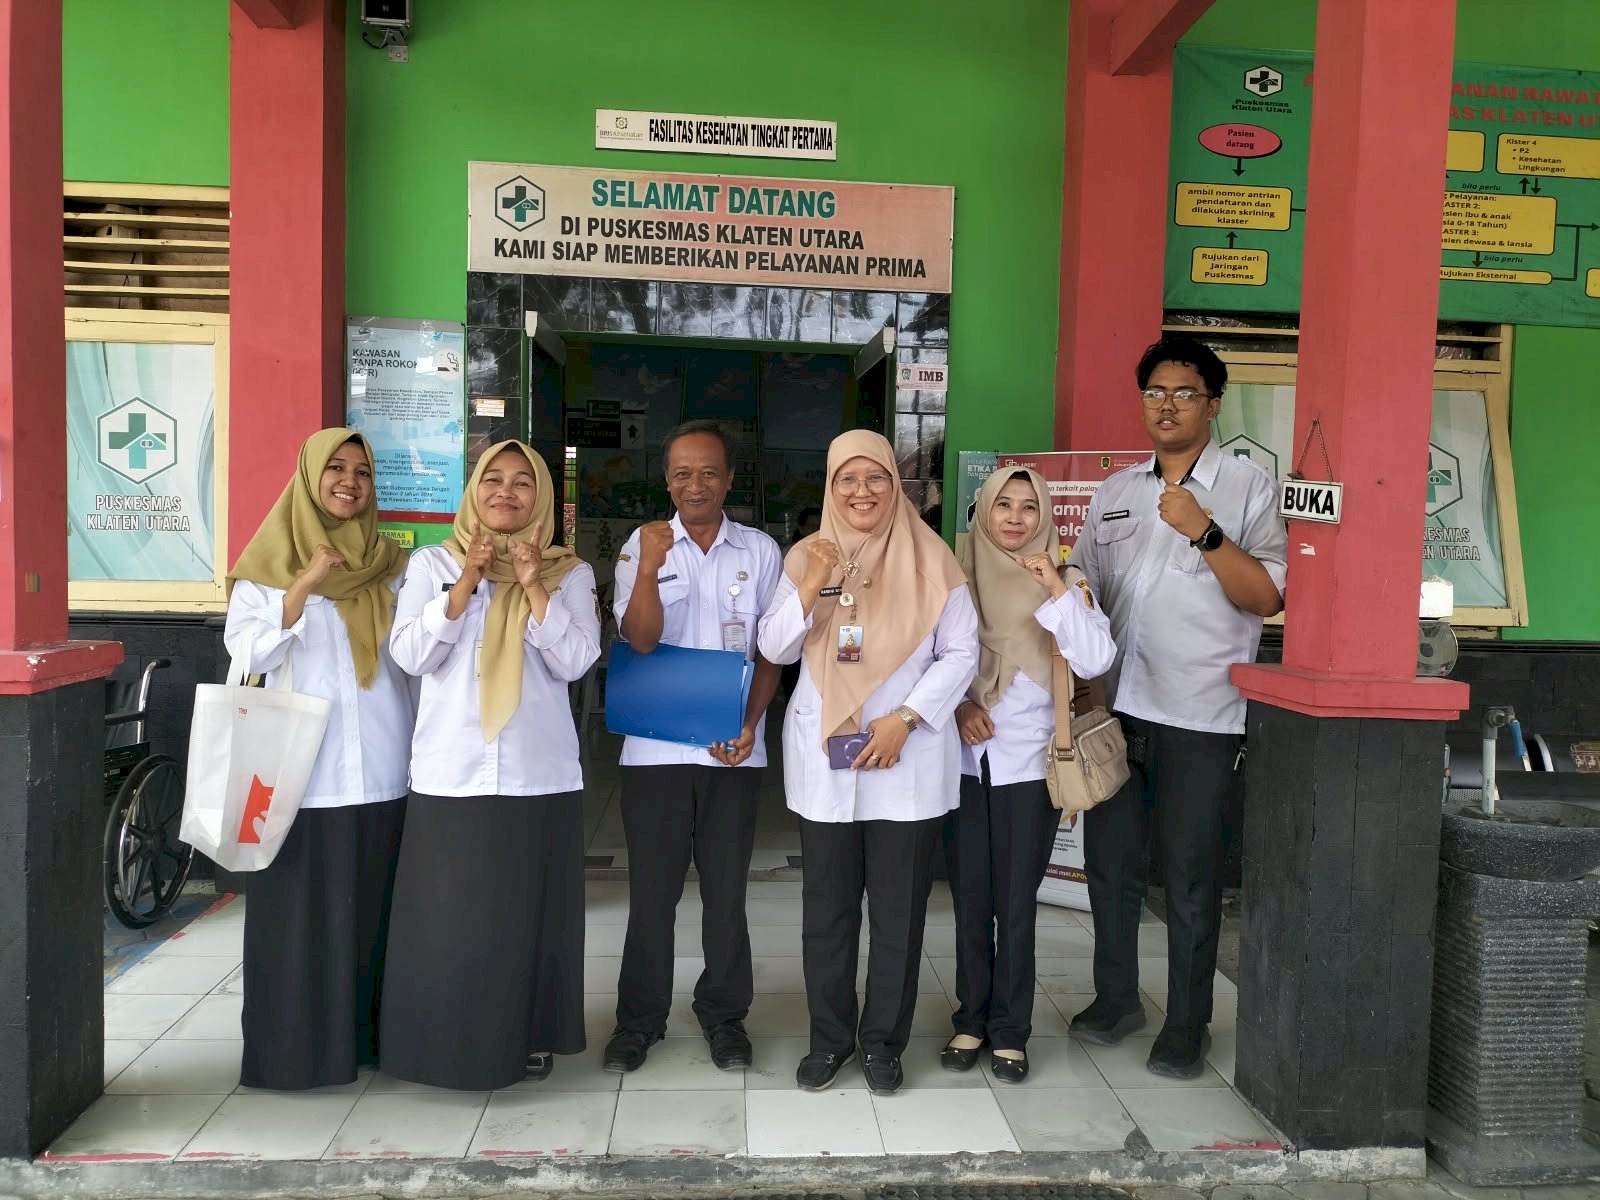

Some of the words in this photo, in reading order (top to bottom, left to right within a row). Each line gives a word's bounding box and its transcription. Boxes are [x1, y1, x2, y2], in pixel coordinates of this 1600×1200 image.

[1266, 106, 1292, 114] Utara
[1482, 108, 1572, 126] KLATEN
[649, 118, 694, 143] FASILITAS
[696, 121, 749, 146] KESEHATAN
[751, 124, 790, 148] TINGKAT
[792, 126, 833, 151] PERTAMA
[1228, 129, 1254, 138] Pasien
[1226, 140, 1255, 150] datang
[1519, 156, 1562, 164] Kesehatan
[1518, 164, 1566, 174] Lingkungan
[1479, 184, 1501, 192] perlu
[592, 178, 720, 213] SELAMAT
[728, 187, 836, 218] DATANG
[1187, 188, 1214, 196] ambil
[1247, 191, 1281, 200] antrian
[1196, 198, 1252, 207] pendaftaran
[1191, 207, 1237, 215] dilakukan
[1239, 209, 1275, 218] skrining
[1217, 217, 1249, 225] klaster
[1478, 222, 1508, 230] Tahun)
[560, 216, 580, 236] DI
[587, 217, 710, 242] PUSKESMAS
[716, 224, 793, 247] KLATEN
[799, 228, 865, 249] UTARA
[1463, 238, 1496, 246] dewasa
[494, 238, 545, 259] KAMI
[552, 241, 599, 262] SIAP
[604, 243, 738, 269] MEMBERIKAN
[745, 251, 860, 275] PELAYANAN
[865, 256, 927, 278] PRIMA
[1202, 253, 1239, 262] Rujukan
[1501, 256, 1524, 264] perlu
[1204, 271, 1255, 280] Puskesmas
[1475, 271, 1517, 280] Eksternal
[352, 348, 401, 358] KAWASAN
[353, 359, 384, 368] TANPA
[918, 370, 944, 382] IMB
[967, 464, 991, 473] ETIKA
[1056, 484, 1079, 492] terkait
[95, 495, 182, 512] PUSKESMAS
[1284, 486, 1335, 515] BUKA
[87, 514, 139, 531] KLATEN
[145, 515, 191, 531] UTARA
[1440, 545, 1481, 561] UTARA
